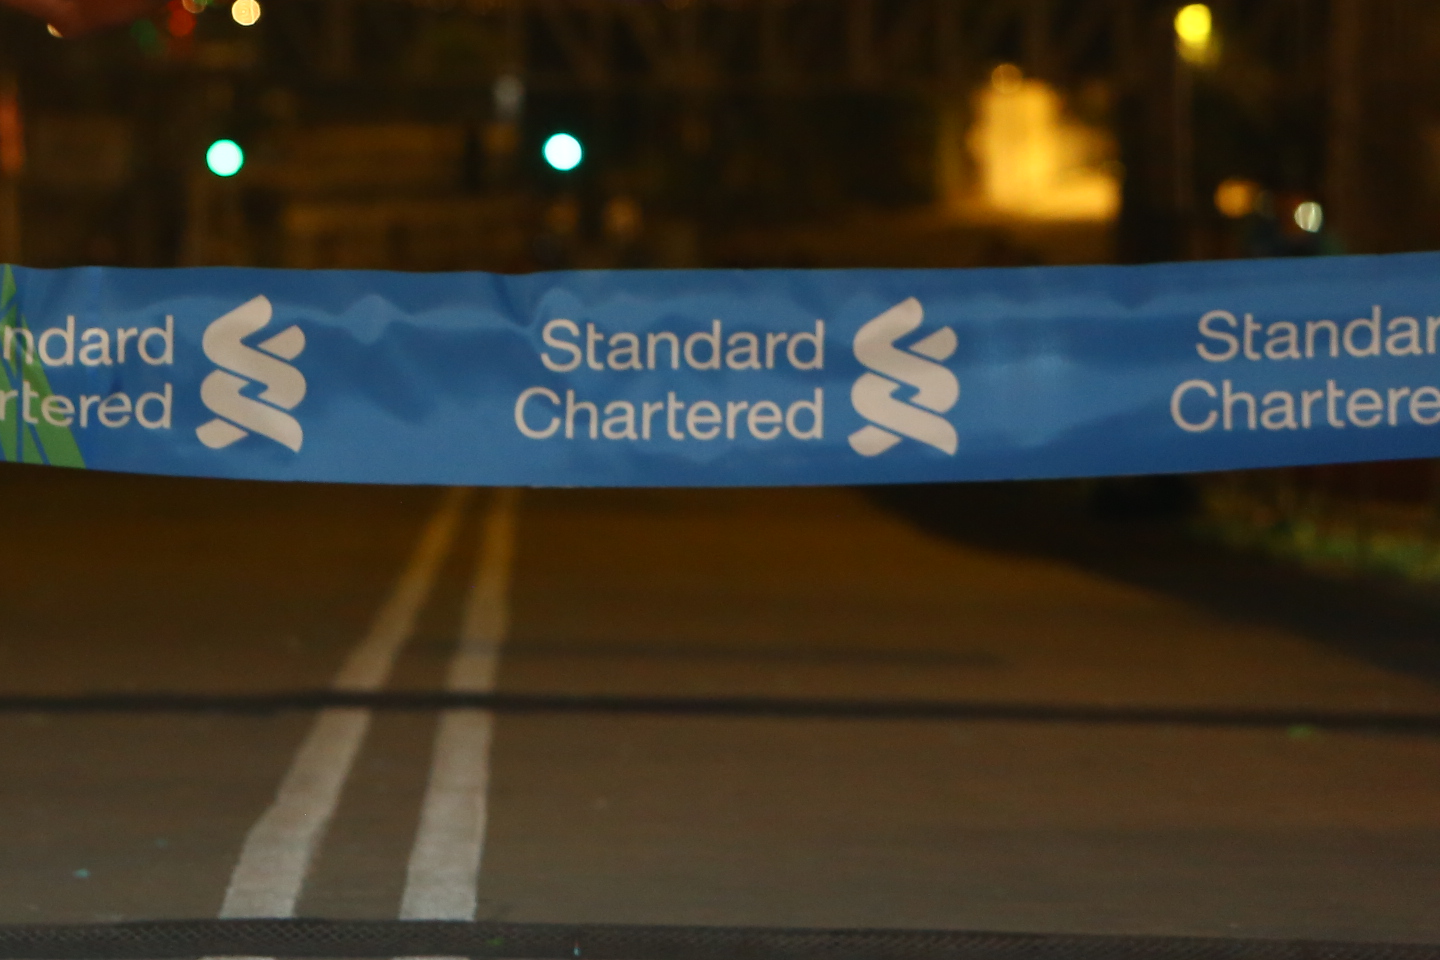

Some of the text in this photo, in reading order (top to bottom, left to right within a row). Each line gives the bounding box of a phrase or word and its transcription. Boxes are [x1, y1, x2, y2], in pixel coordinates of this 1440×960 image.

[540, 318, 824, 372] Standard
[513, 387, 823, 441] Chartered
[1169, 379, 1440, 433] Chartere
